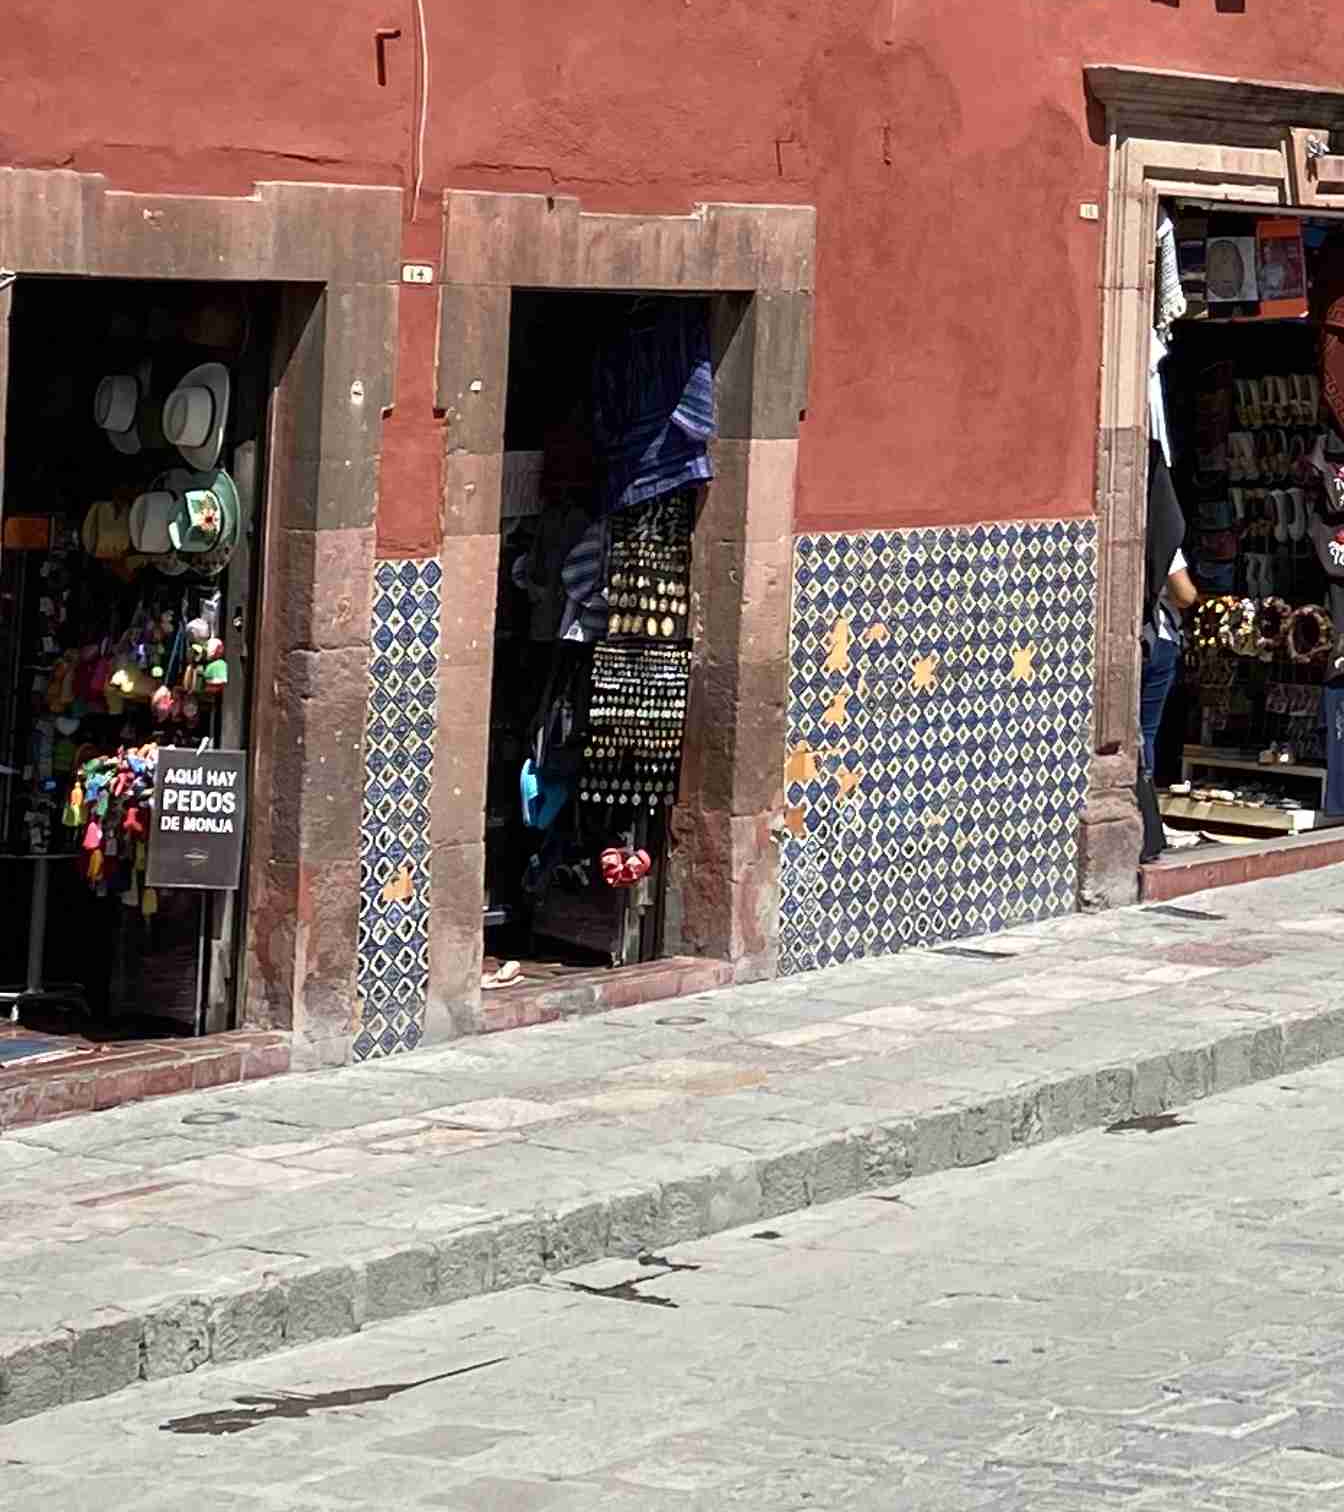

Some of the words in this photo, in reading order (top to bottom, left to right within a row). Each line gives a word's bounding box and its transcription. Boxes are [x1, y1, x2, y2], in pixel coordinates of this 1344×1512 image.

[164, 767, 203, 785] AQUÍ
[206, 770, 237, 787] HAY
[162, 789, 236, 814] PEDOS
[160, 816, 180, 831] DE
[183, 816, 234, 833] MONJA
